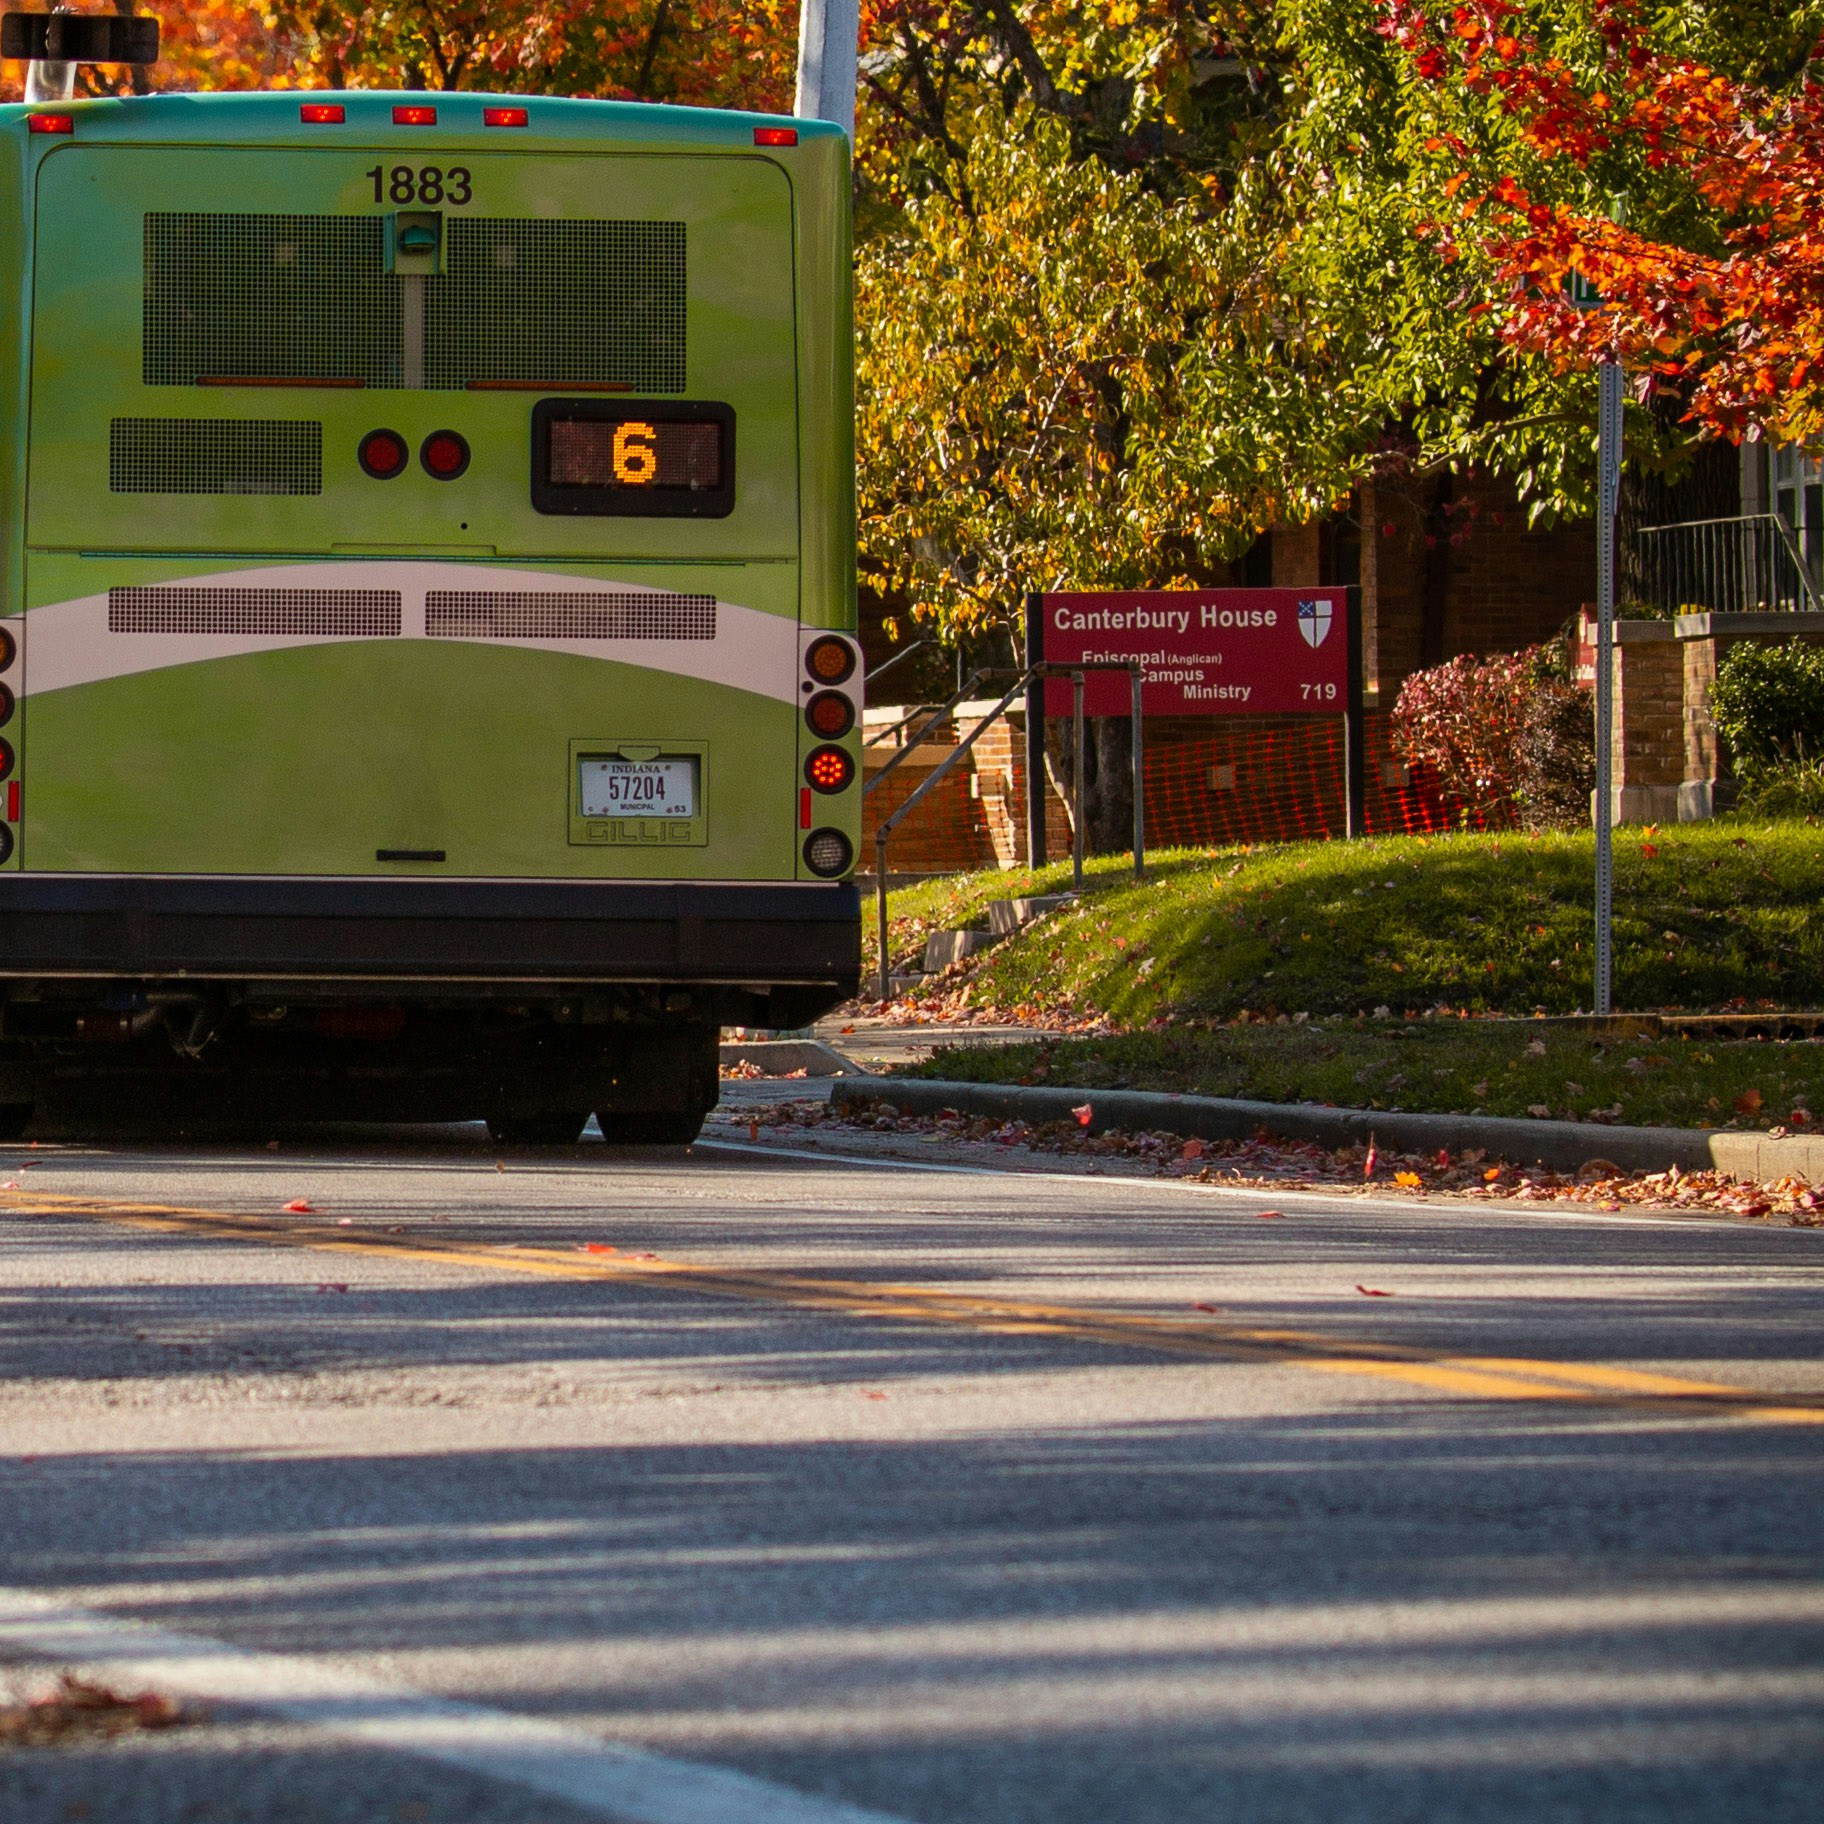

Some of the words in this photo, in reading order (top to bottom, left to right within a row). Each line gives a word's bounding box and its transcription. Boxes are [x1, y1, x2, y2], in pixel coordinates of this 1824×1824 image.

[366, 165, 473, 206] 1883
[612, 422, 657, 484] 6
[1054, 606, 1190, 634] Canterbury
[1200, 605, 1278, 628] House
[1081, 649, 1166, 667] Episcopal
[1167, 652, 1223, 666] (Anglican)
[1139, 668, 1205, 685] Campus
[1183, 684, 1252, 702] Ministry
[1300, 682, 1337, 700] 719
[611, 765, 661, 774] INDIANA
[608, 776, 666, 801] 57204
[619, 803, 655, 811] MUNICIPAL
[674, 805, 687, 813] 53
[585, 821, 691, 842] GILLIG
